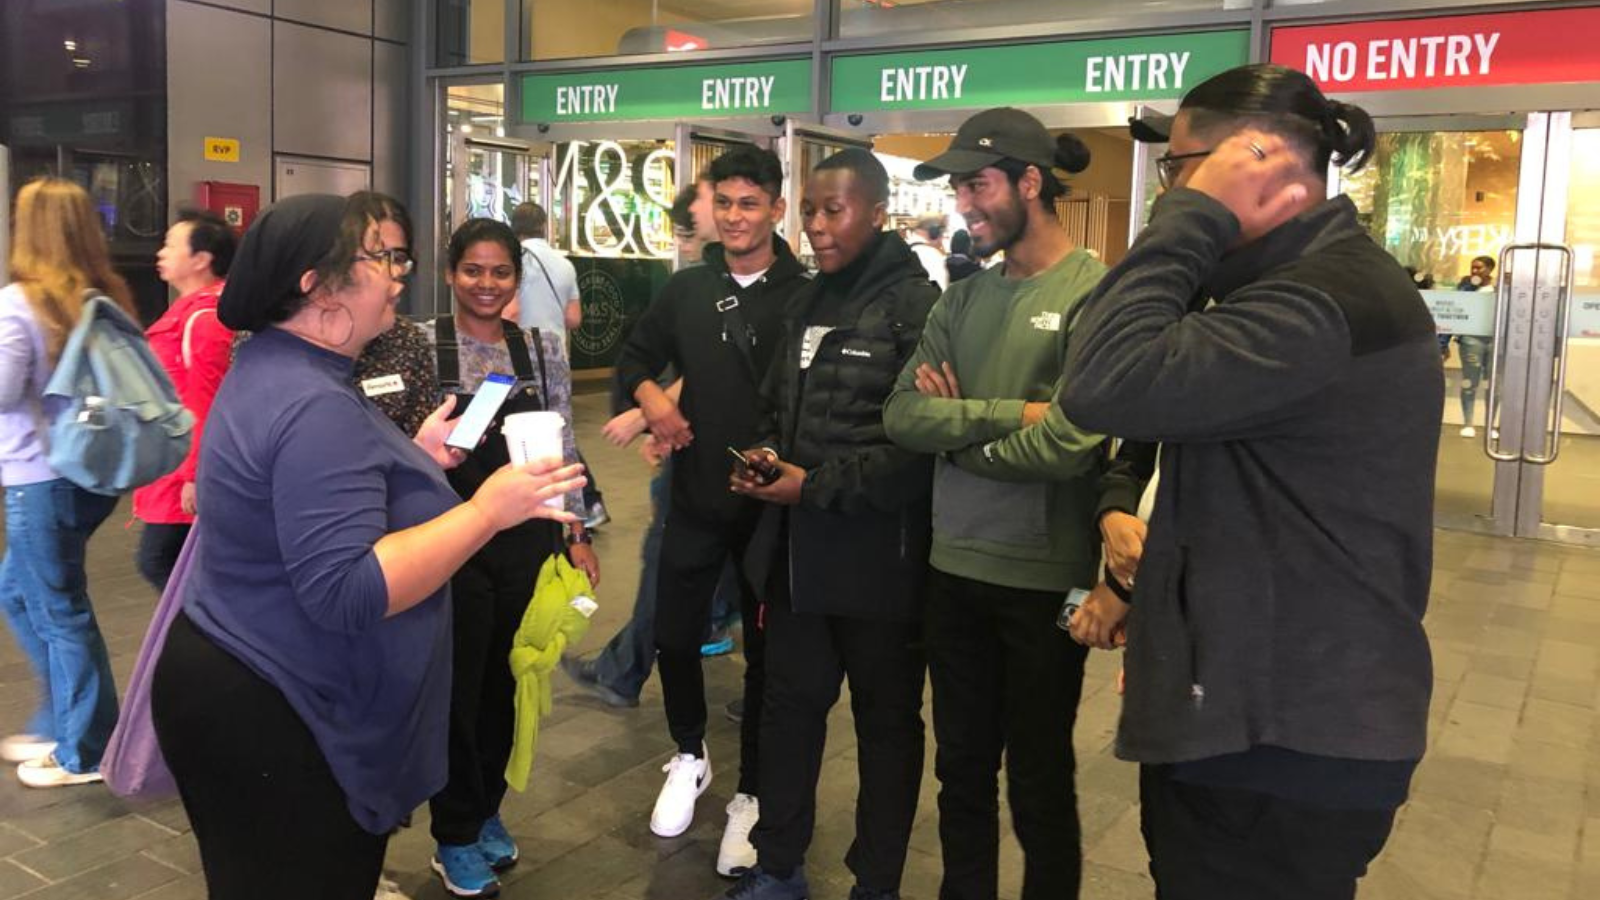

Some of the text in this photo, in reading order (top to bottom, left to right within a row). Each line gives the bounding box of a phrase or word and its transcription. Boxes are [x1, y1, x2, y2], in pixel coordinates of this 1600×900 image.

[1085, 51, 1190, 93] ENTRY
[1305, 32, 1500, 82] NO ENTRY
[557, 84, 618, 115] ENTRY
[701, 76, 775, 110] ENTRY
[880, 64, 968, 102] ENTRY
[212, 144, 231, 154] RVP
